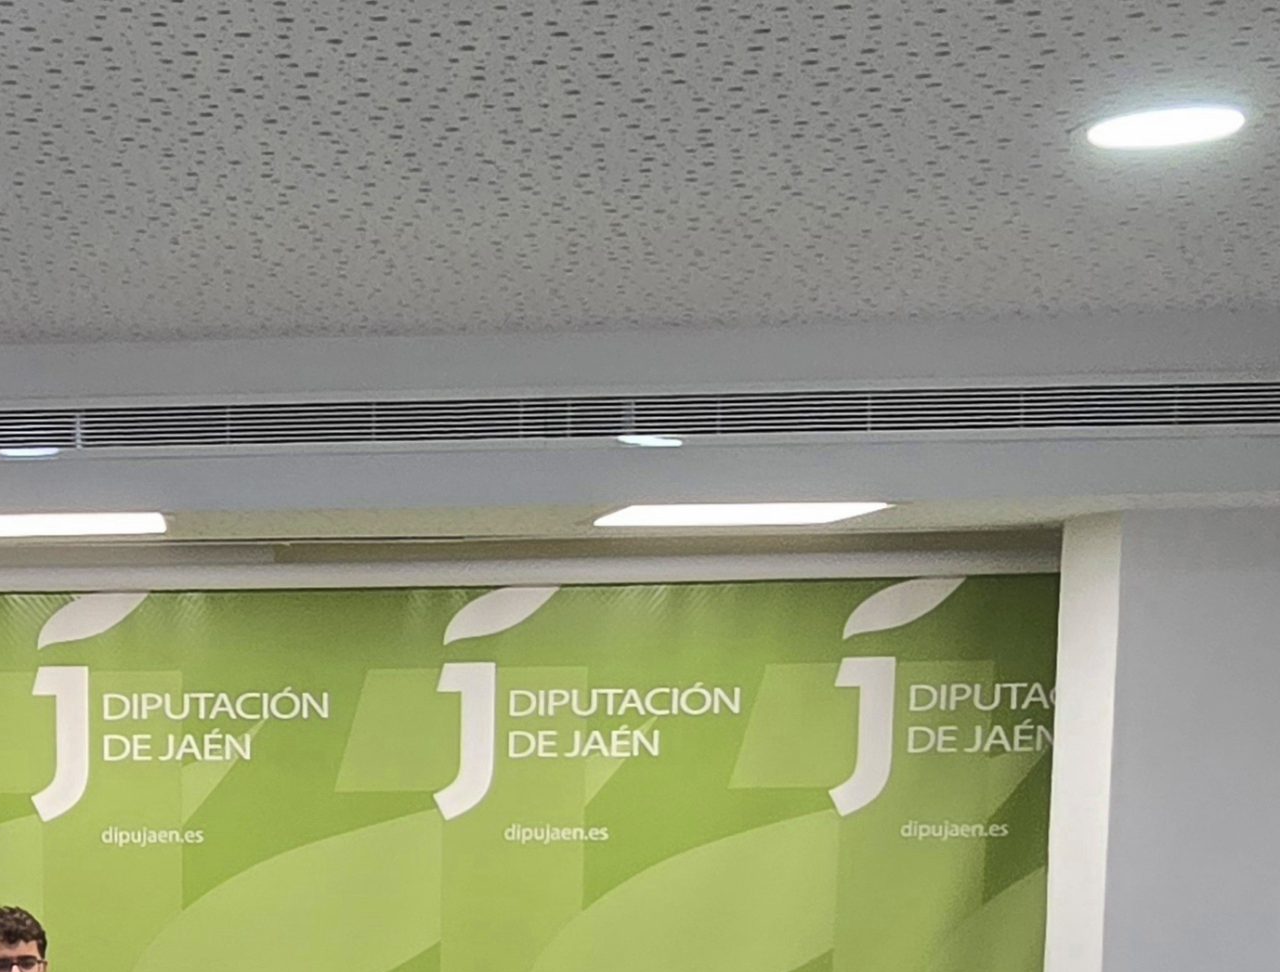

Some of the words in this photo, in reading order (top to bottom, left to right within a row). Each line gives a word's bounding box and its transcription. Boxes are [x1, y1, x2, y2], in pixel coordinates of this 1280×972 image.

[102, 686, 329, 721] DIPUTACIÓN
[508, 682, 741, 717] DIPUTACIÓN
[909, 682, 1057, 712] DIPUTA
[103, 734, 152, 761] DE
[158, 728, 251, 761] JAÉN
[508, 730, 558, 758] DE
[564, 724, 660, 757] JAÉN
[907, 726, 959, 754] DE
[101, 826, 204, 847] dipujaen.es
[504, 823, 609, 844] dipujaen.es
[900, 820, 1009, 841] dipujaen.es
